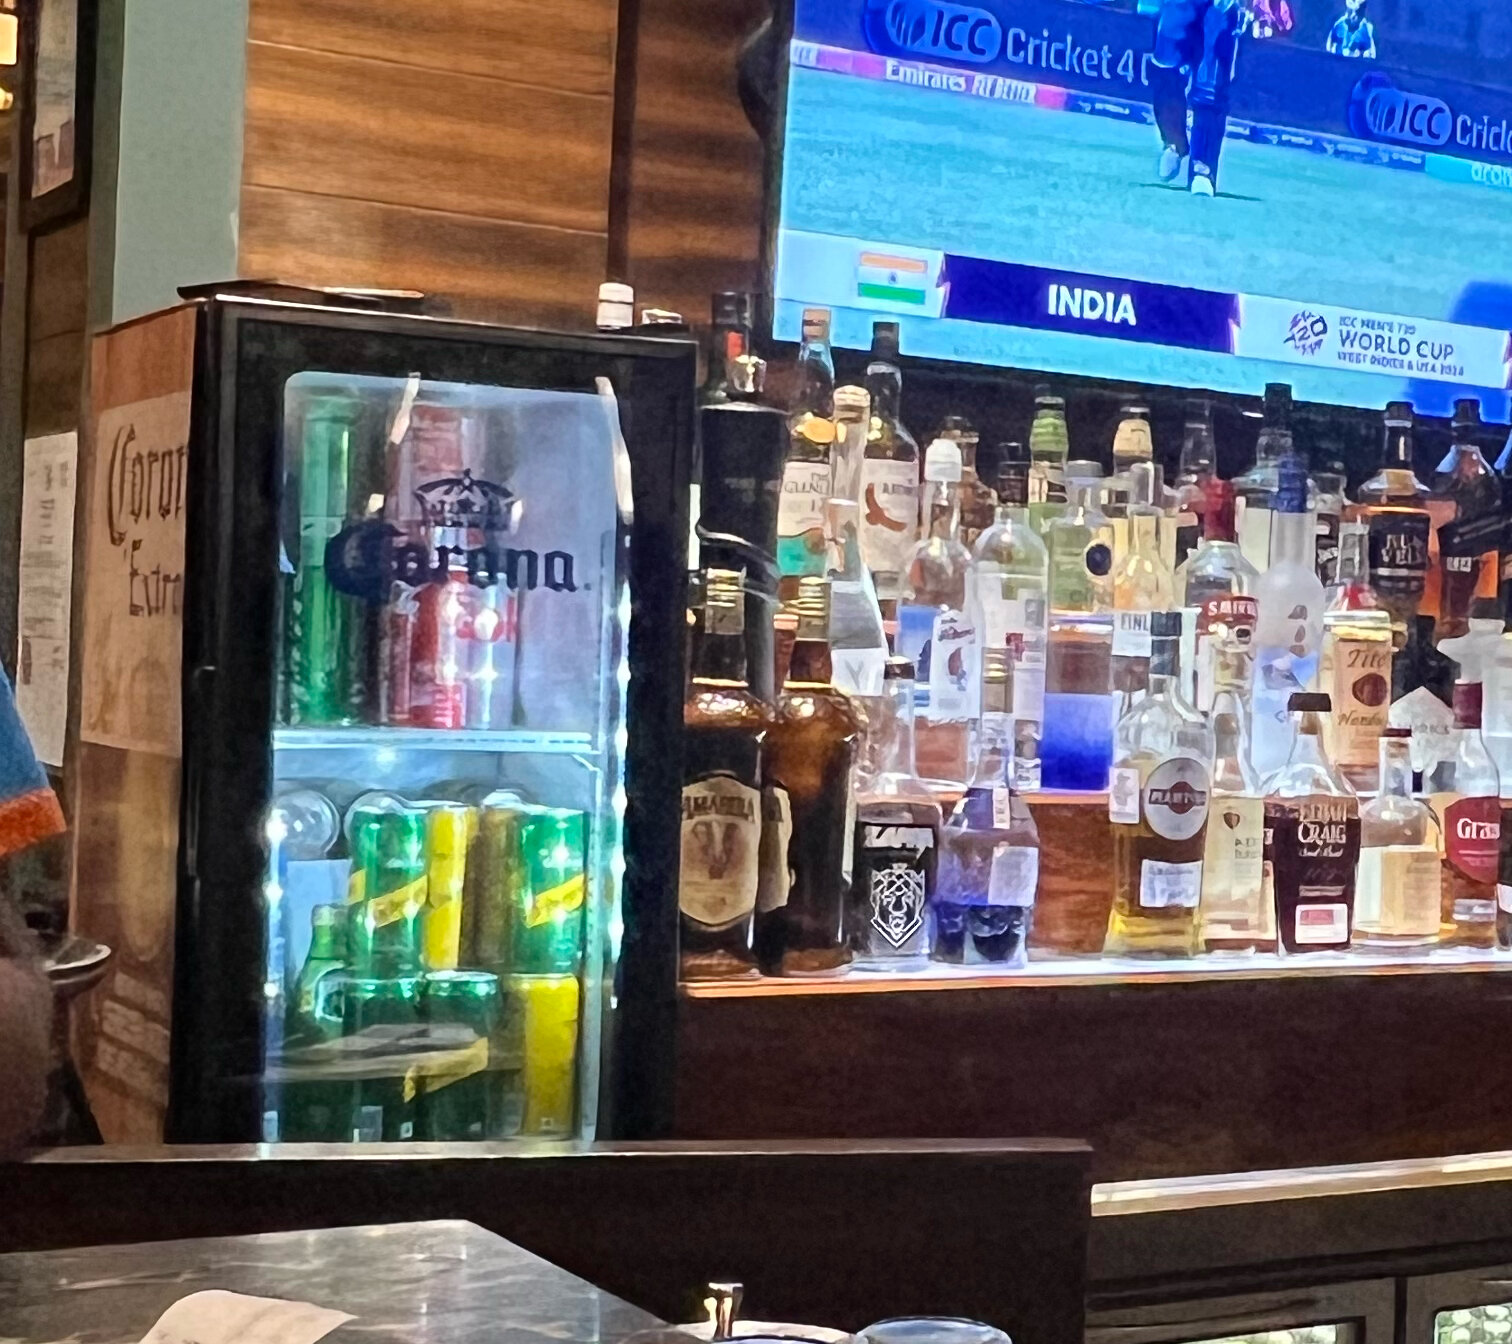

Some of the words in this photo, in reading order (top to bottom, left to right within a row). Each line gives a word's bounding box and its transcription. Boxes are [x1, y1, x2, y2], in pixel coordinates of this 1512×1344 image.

[931, 9, 993, 56] ICC
[1006, 27, 1112, 80] Cricket
[886, 61, 967, 93] Emirates
[1398, 97, 1446, 140] ICC
[1047, 282, 1138, 327] INDIA
[1339, 329, 1411, 356] WORLD
[1416, 340, 1454, 361] CUP
[325, 520, 578, 598] Corona
[1297, 821, 1347, 845] CRAIG
